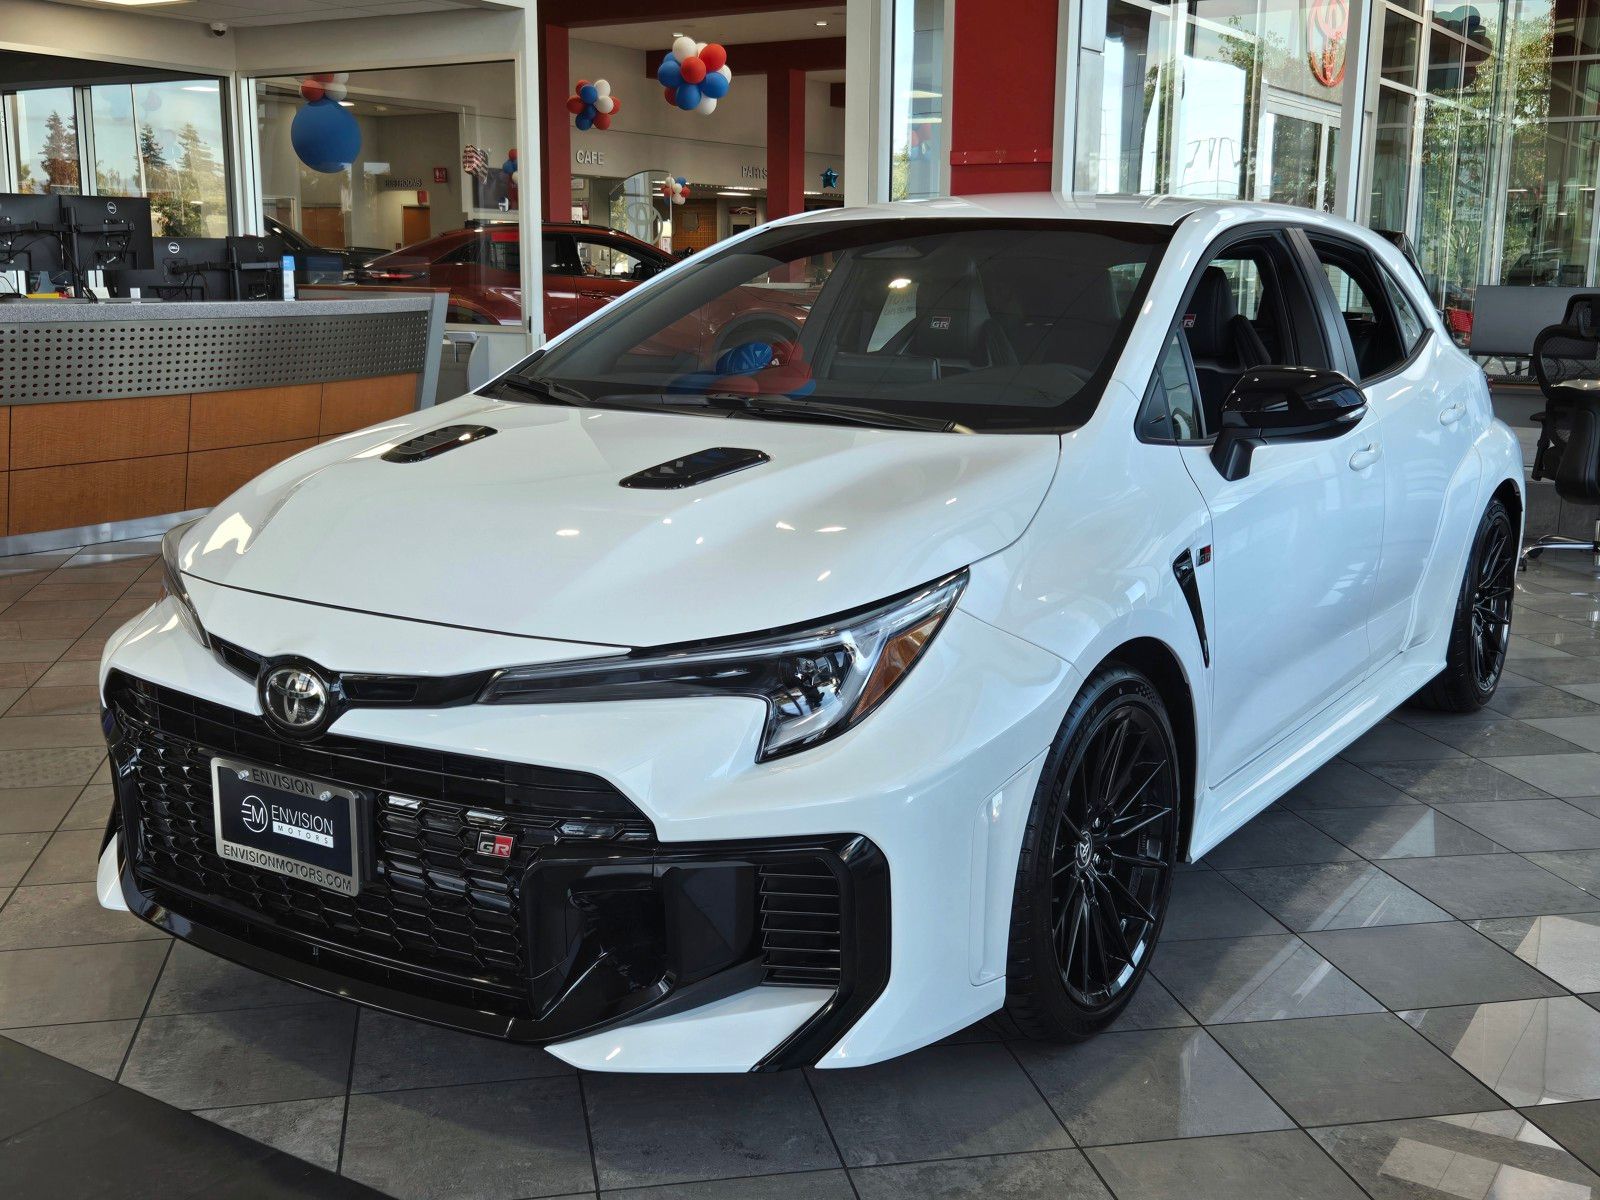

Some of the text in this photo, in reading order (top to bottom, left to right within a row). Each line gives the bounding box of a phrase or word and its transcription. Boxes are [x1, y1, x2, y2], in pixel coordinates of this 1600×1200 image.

[576, 150, 605, 165] CAFE
[741, 166, 768, 179] PARTS
[931, 320, 949, 329] GR
[252, 768, 315, 795] ENVISION
[271, 804, 333, 835] ENVISION
[277, 825, 329, 845] MOTORS
[479, 841, 510, 856] GR
[223, 844, 351, 890] ENVISIONMOTORS.COM
